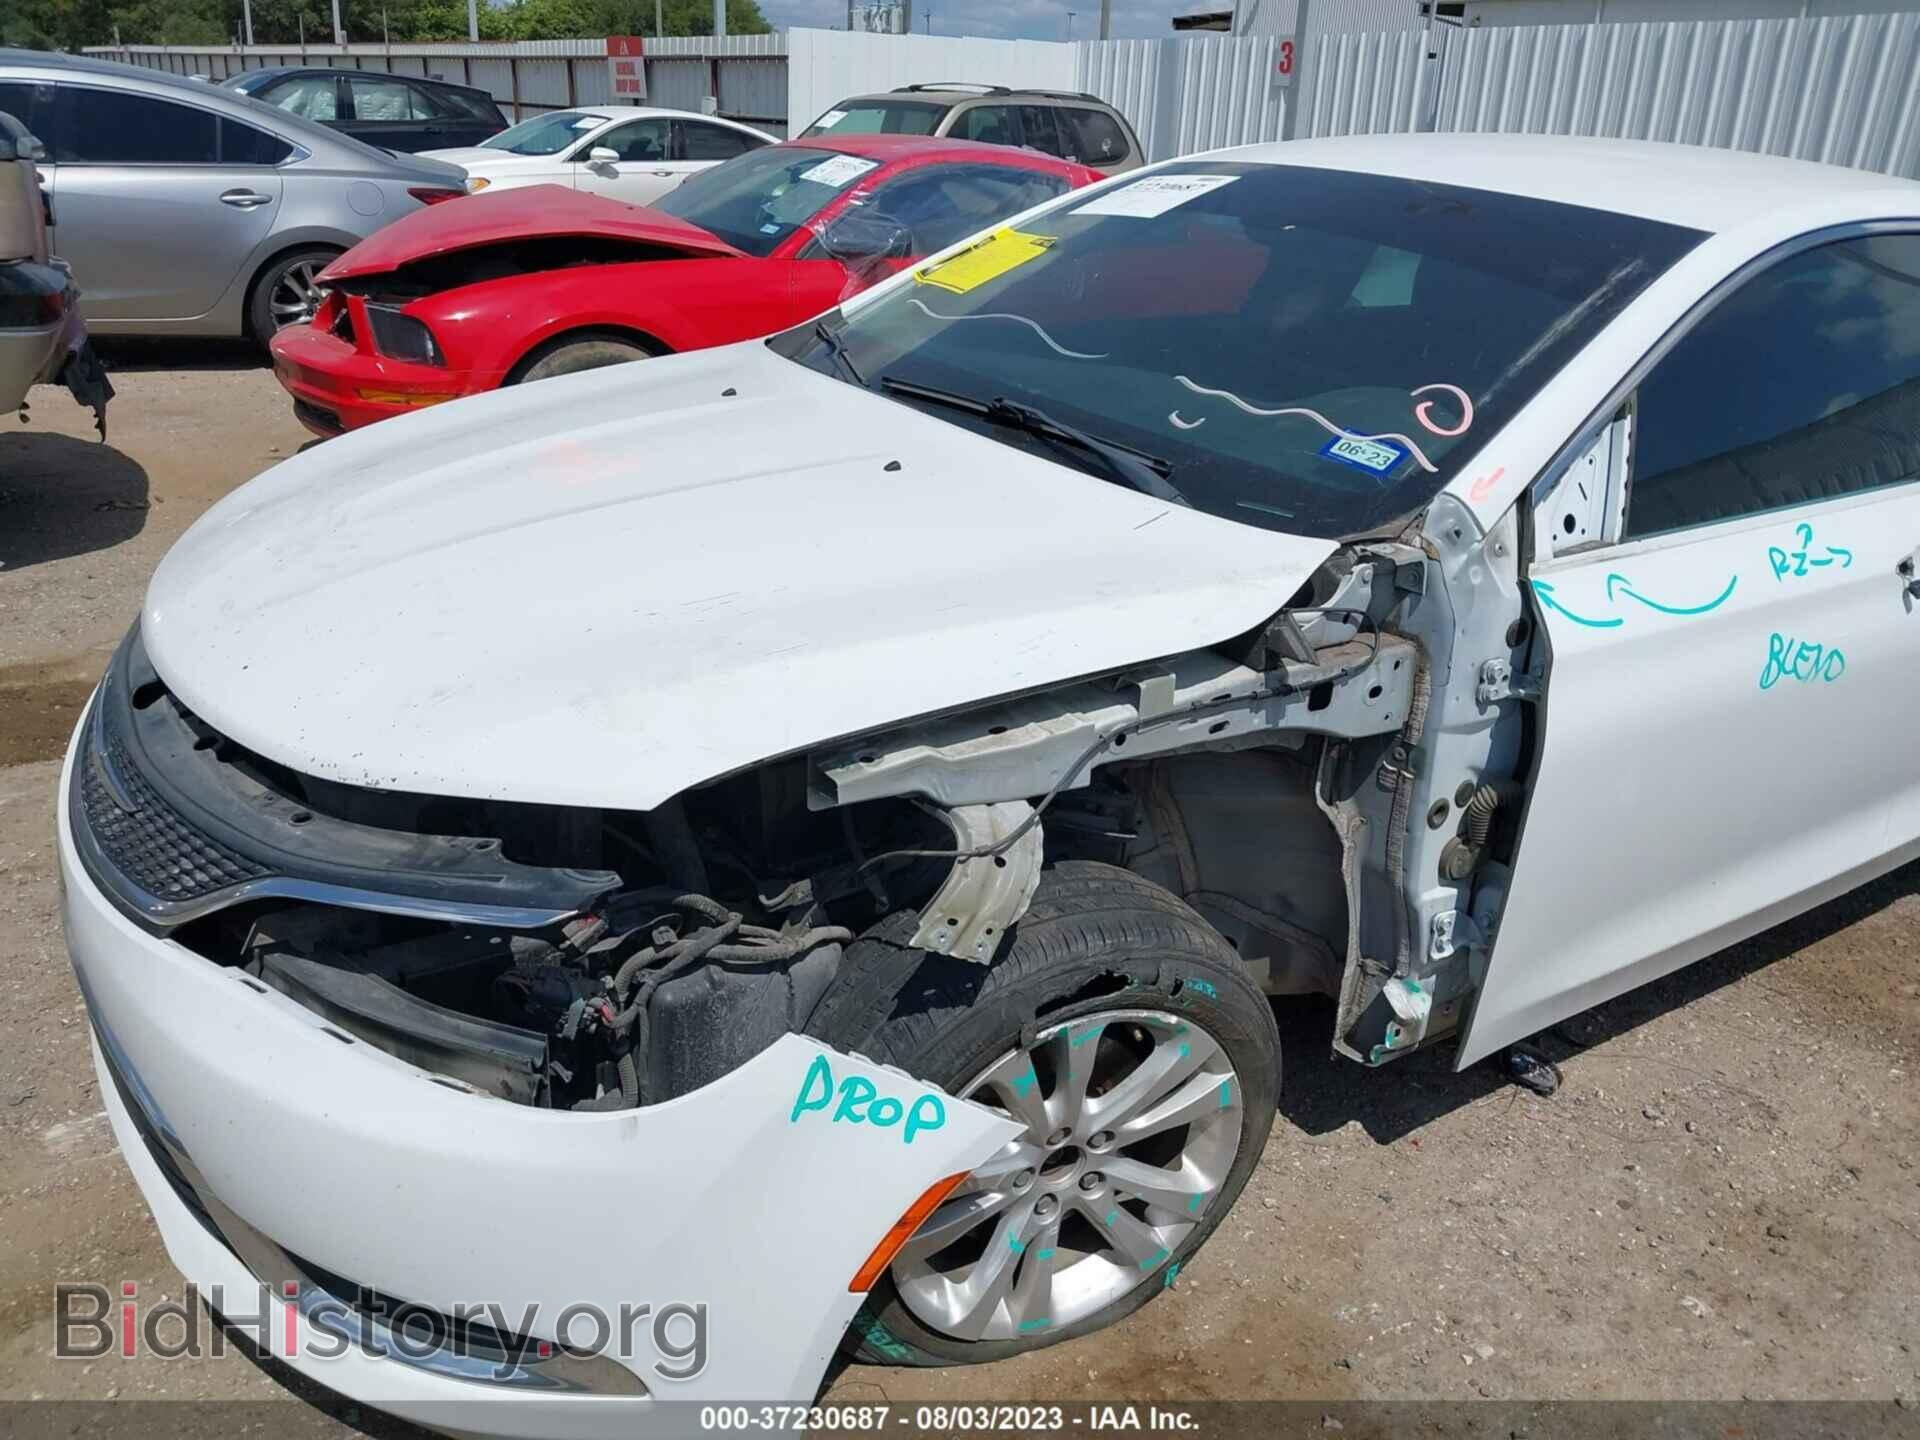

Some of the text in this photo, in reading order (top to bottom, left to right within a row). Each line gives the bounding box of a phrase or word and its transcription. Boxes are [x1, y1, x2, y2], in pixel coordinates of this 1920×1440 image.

[1279, 40, 1293, 74] 3
[1337, 441, 1362, 456] 06
[1364, 451, 1391, 467] 23
[790, 1054, 946, 1144] DROP
